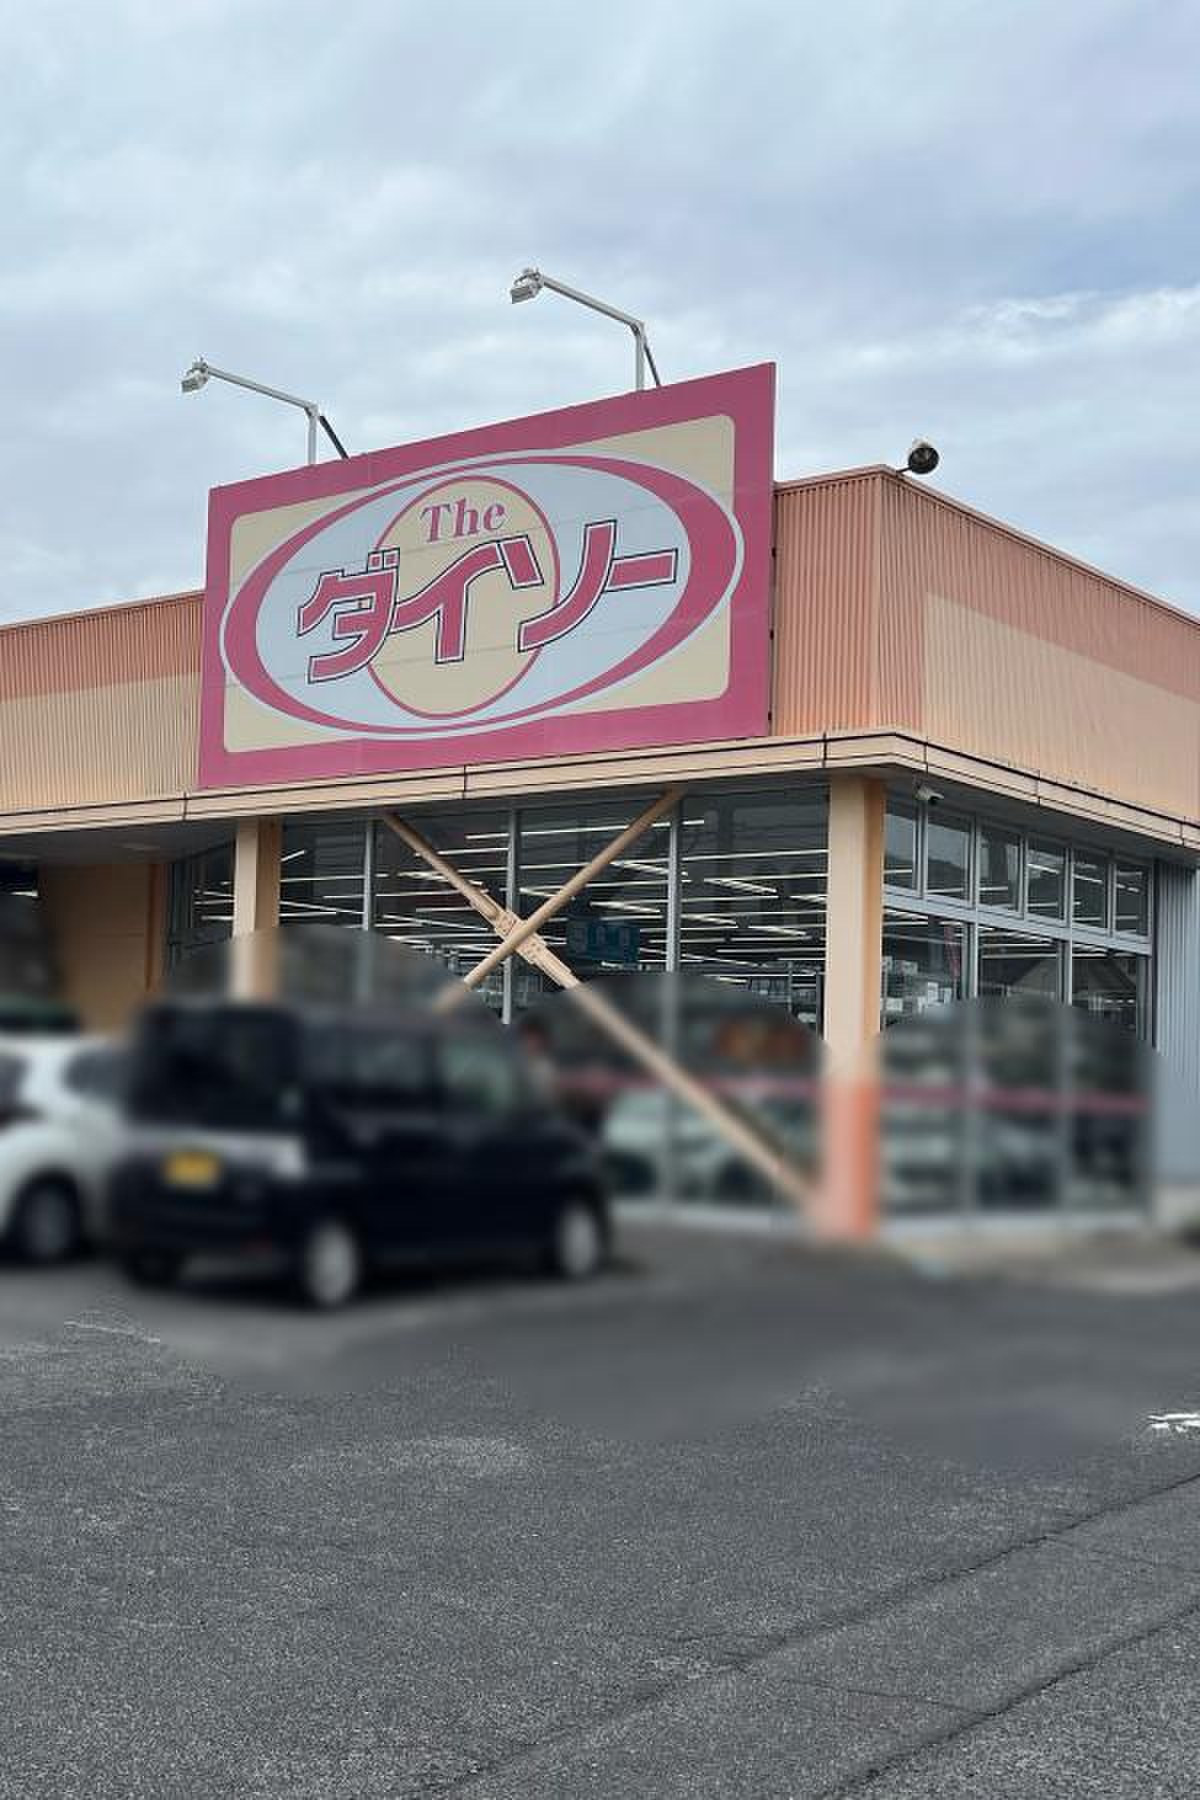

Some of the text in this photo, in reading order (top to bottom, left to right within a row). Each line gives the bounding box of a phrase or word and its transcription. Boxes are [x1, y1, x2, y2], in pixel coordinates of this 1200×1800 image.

[420, 497, 506, 543] The
[297, 519, 679, 684] ダイソー
